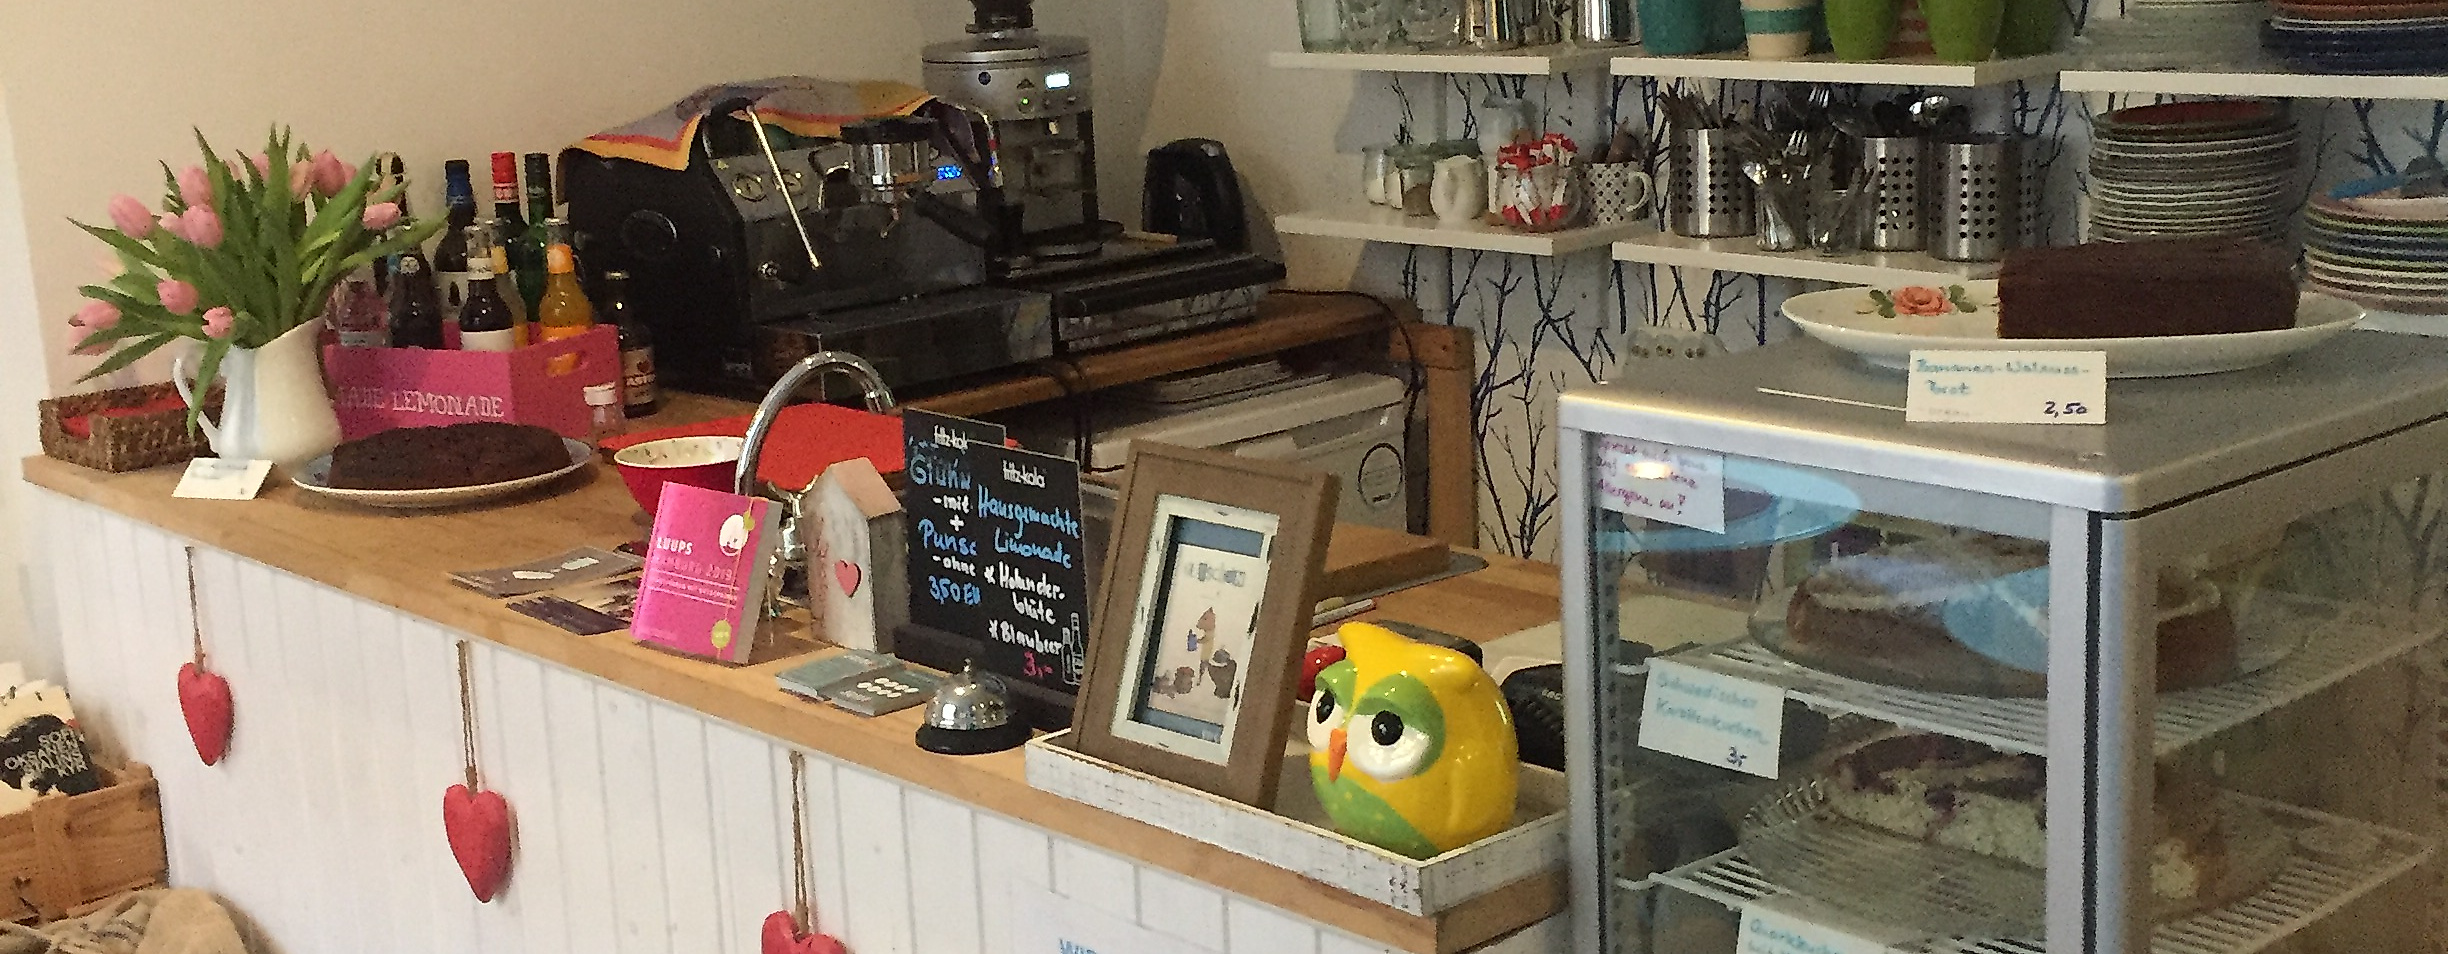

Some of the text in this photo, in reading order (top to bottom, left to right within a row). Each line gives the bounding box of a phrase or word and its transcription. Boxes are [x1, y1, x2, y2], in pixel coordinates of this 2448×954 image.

[392, 389, 505, 418] LEMONADE
[2043, 400, 2088, 418] 2,50
[933, 424, 969, 451] fritz-kol
[1002, 458, 1046, 488] fritz-kola
[978, 483, 1081, 540] Hausgemachte
[656, 536, 694, 555] LUUPS
[918, 518, 977, 555] Punsc
[994, 526, 1073, 569] Limonade
[4, 738, 79, 771] OKSANEN
